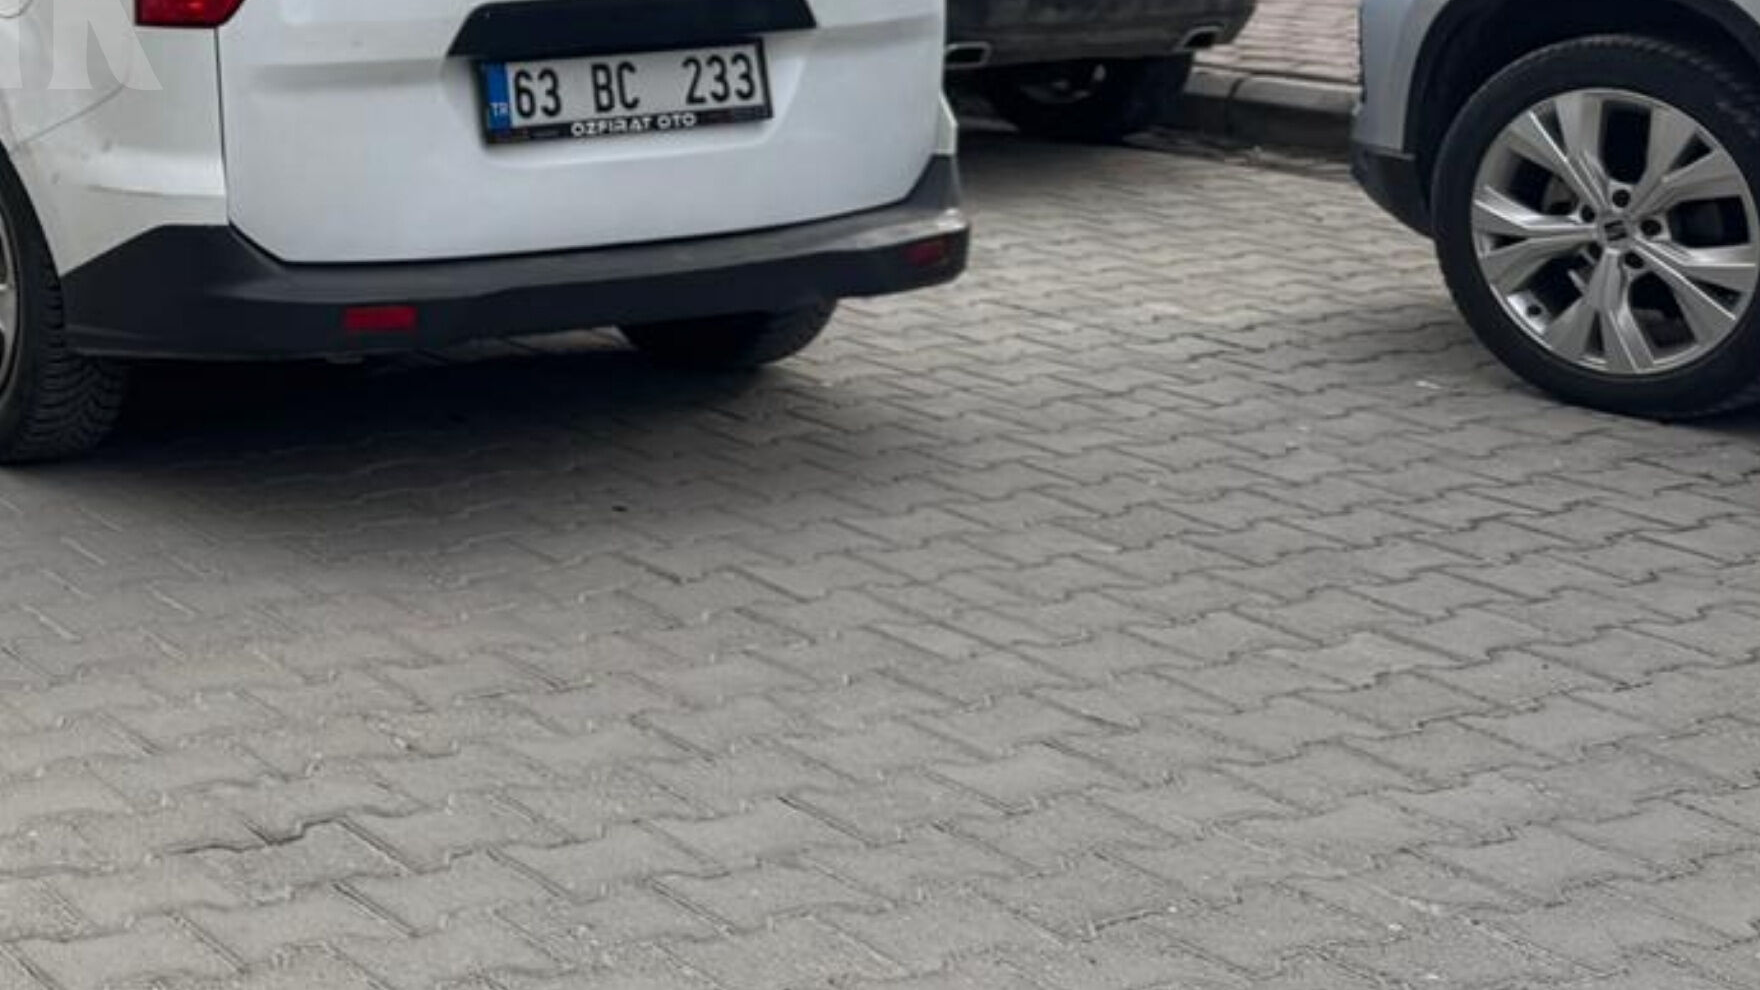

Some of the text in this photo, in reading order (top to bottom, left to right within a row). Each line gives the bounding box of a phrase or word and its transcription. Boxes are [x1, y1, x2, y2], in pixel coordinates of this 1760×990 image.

[514, 53, 756, 119] 63 BC 233
[491, 102, 509, 116] TR
[657, 113, 697, 129] OTO
